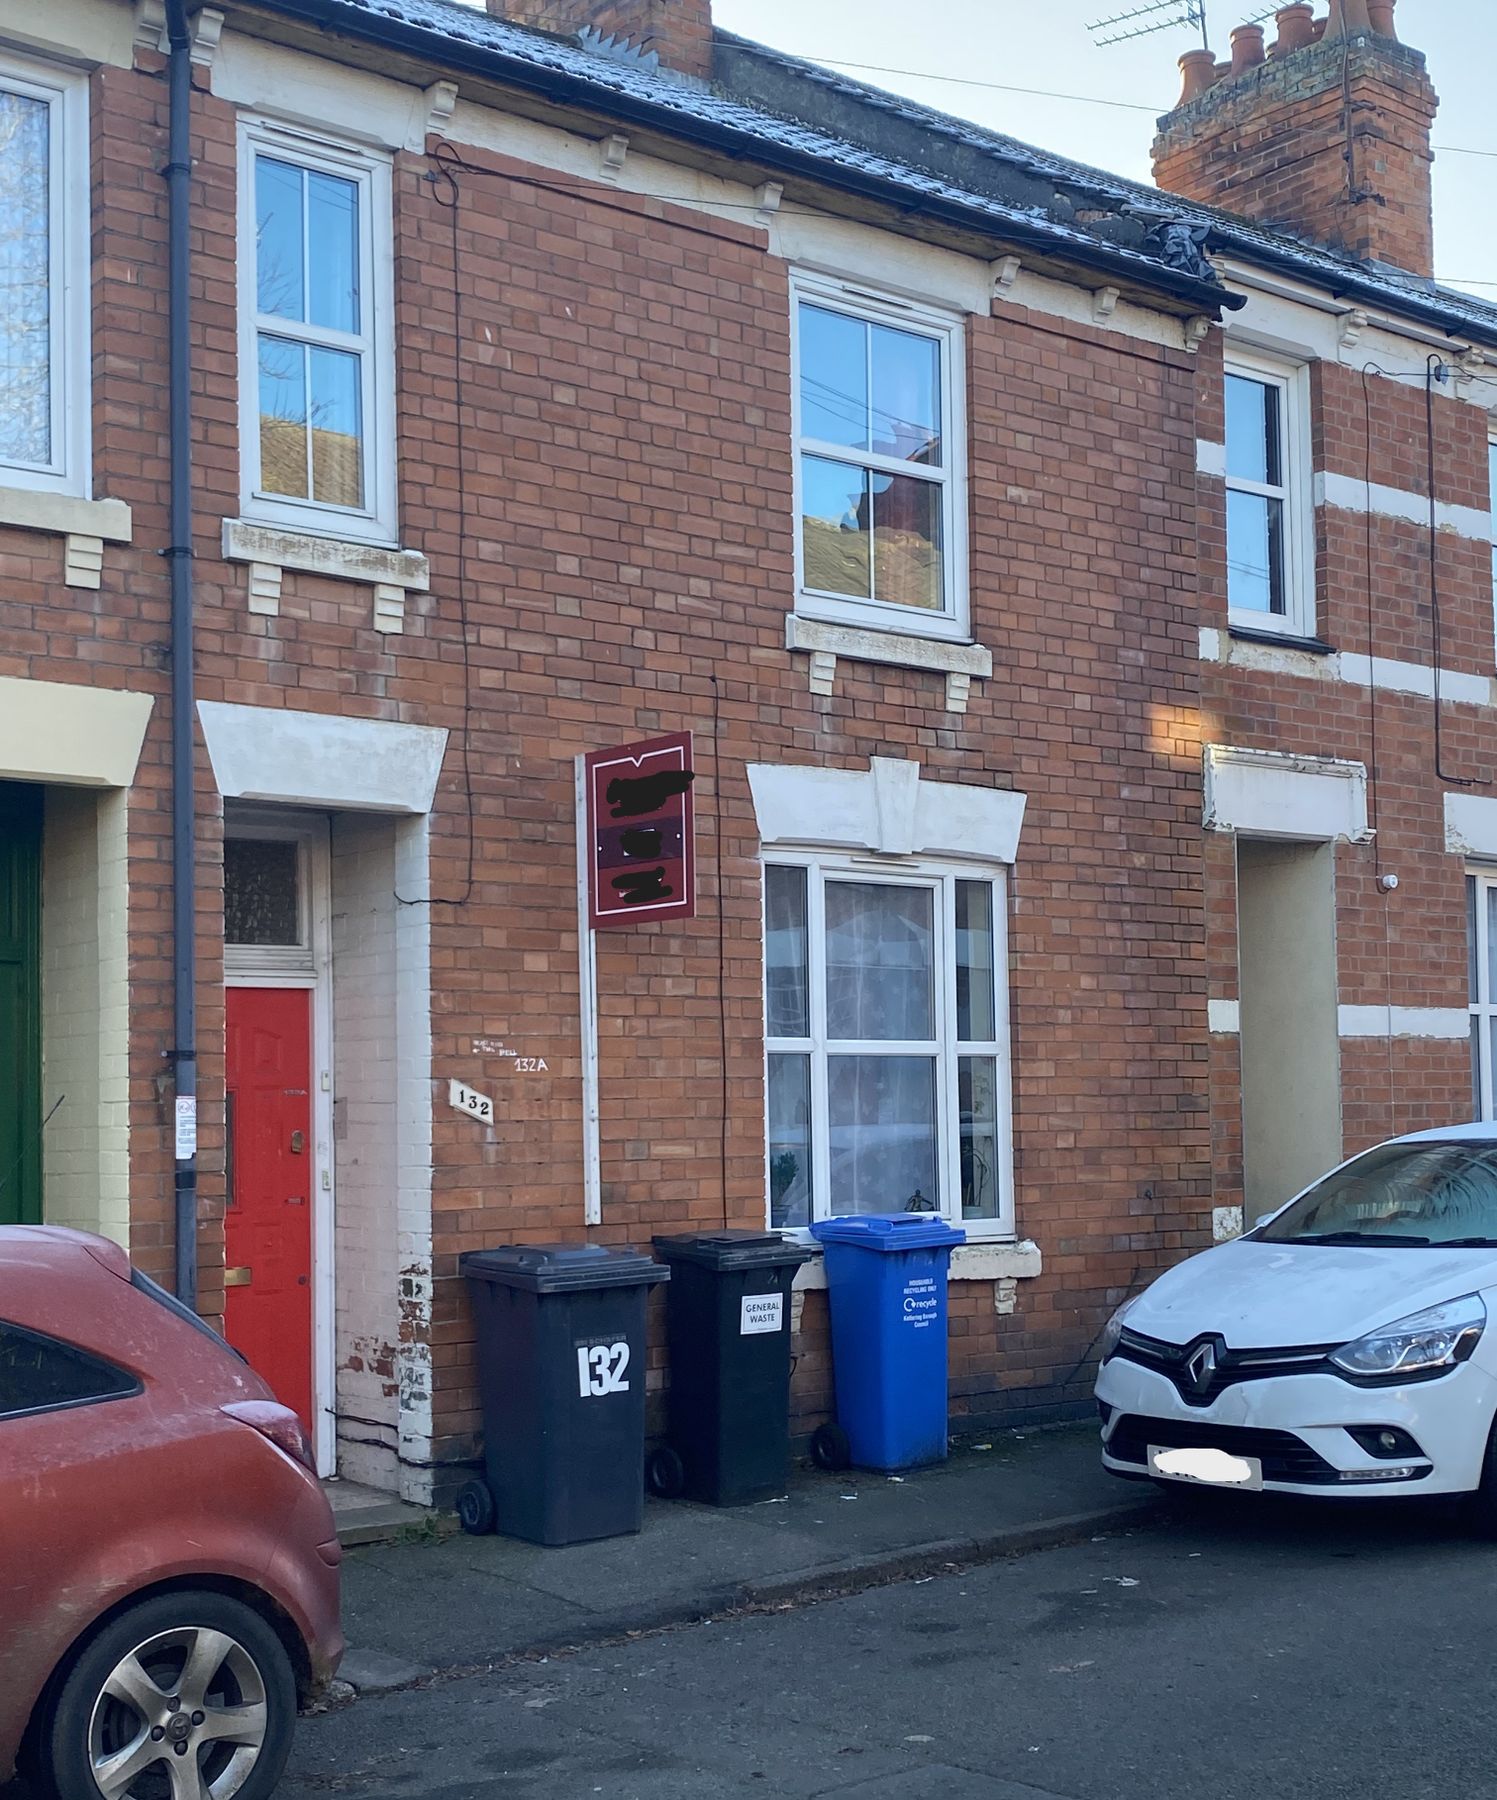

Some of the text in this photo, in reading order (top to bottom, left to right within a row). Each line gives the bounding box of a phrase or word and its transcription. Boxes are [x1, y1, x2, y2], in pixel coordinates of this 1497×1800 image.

[514, 1058, 549, 1072] 132A
[459, 1089, 490, 1116] 132
[745, 1302, 780, 1313] GENERAL
[916, 1297, 938, 1309] recycle
[750, 1313, 776, 1323] WASTE
[577, 1342, 630, 1398] 132
